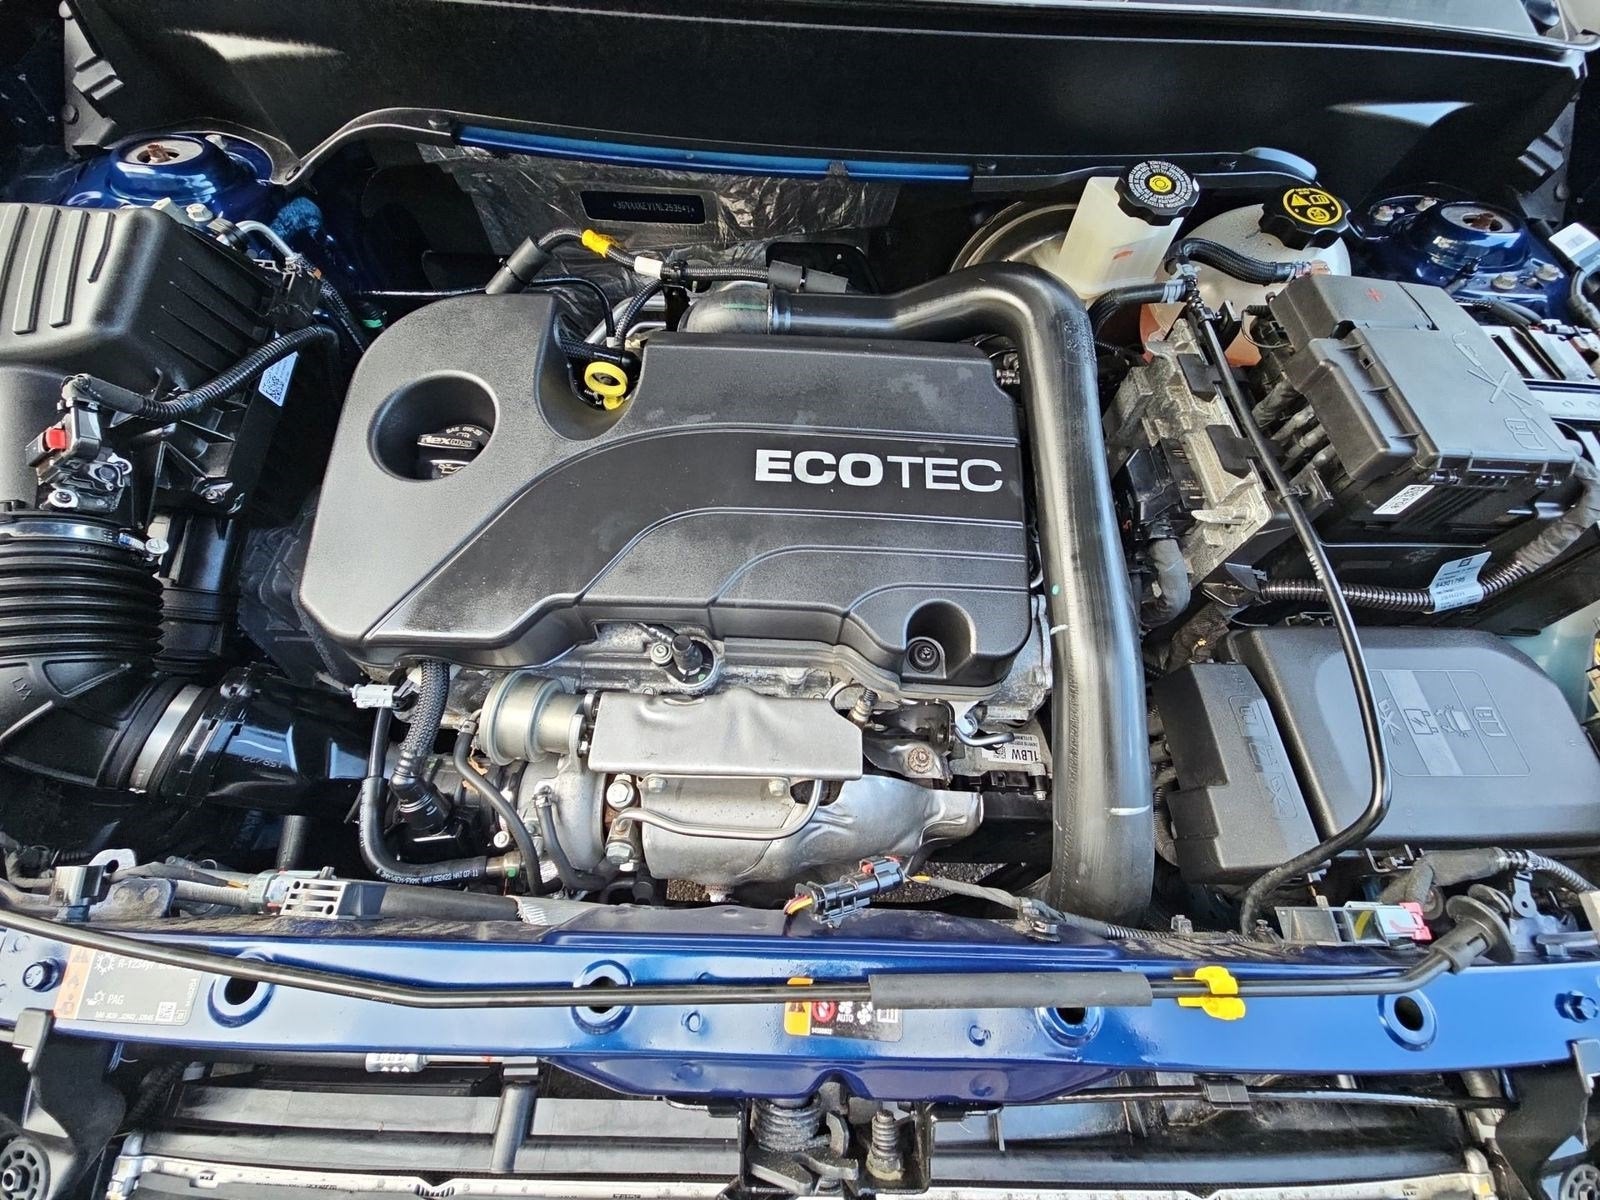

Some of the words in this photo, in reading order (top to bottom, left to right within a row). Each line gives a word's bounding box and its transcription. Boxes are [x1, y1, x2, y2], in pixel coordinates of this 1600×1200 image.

[446, 426, 460, 434] SAE
[755, 449, 1003, 493] ECOTEC
[1011, 748, 1039, 762] 1LBW
[106, 993, 125, 1006] PAG
[836, 1012, 854, 1022] AUTO
